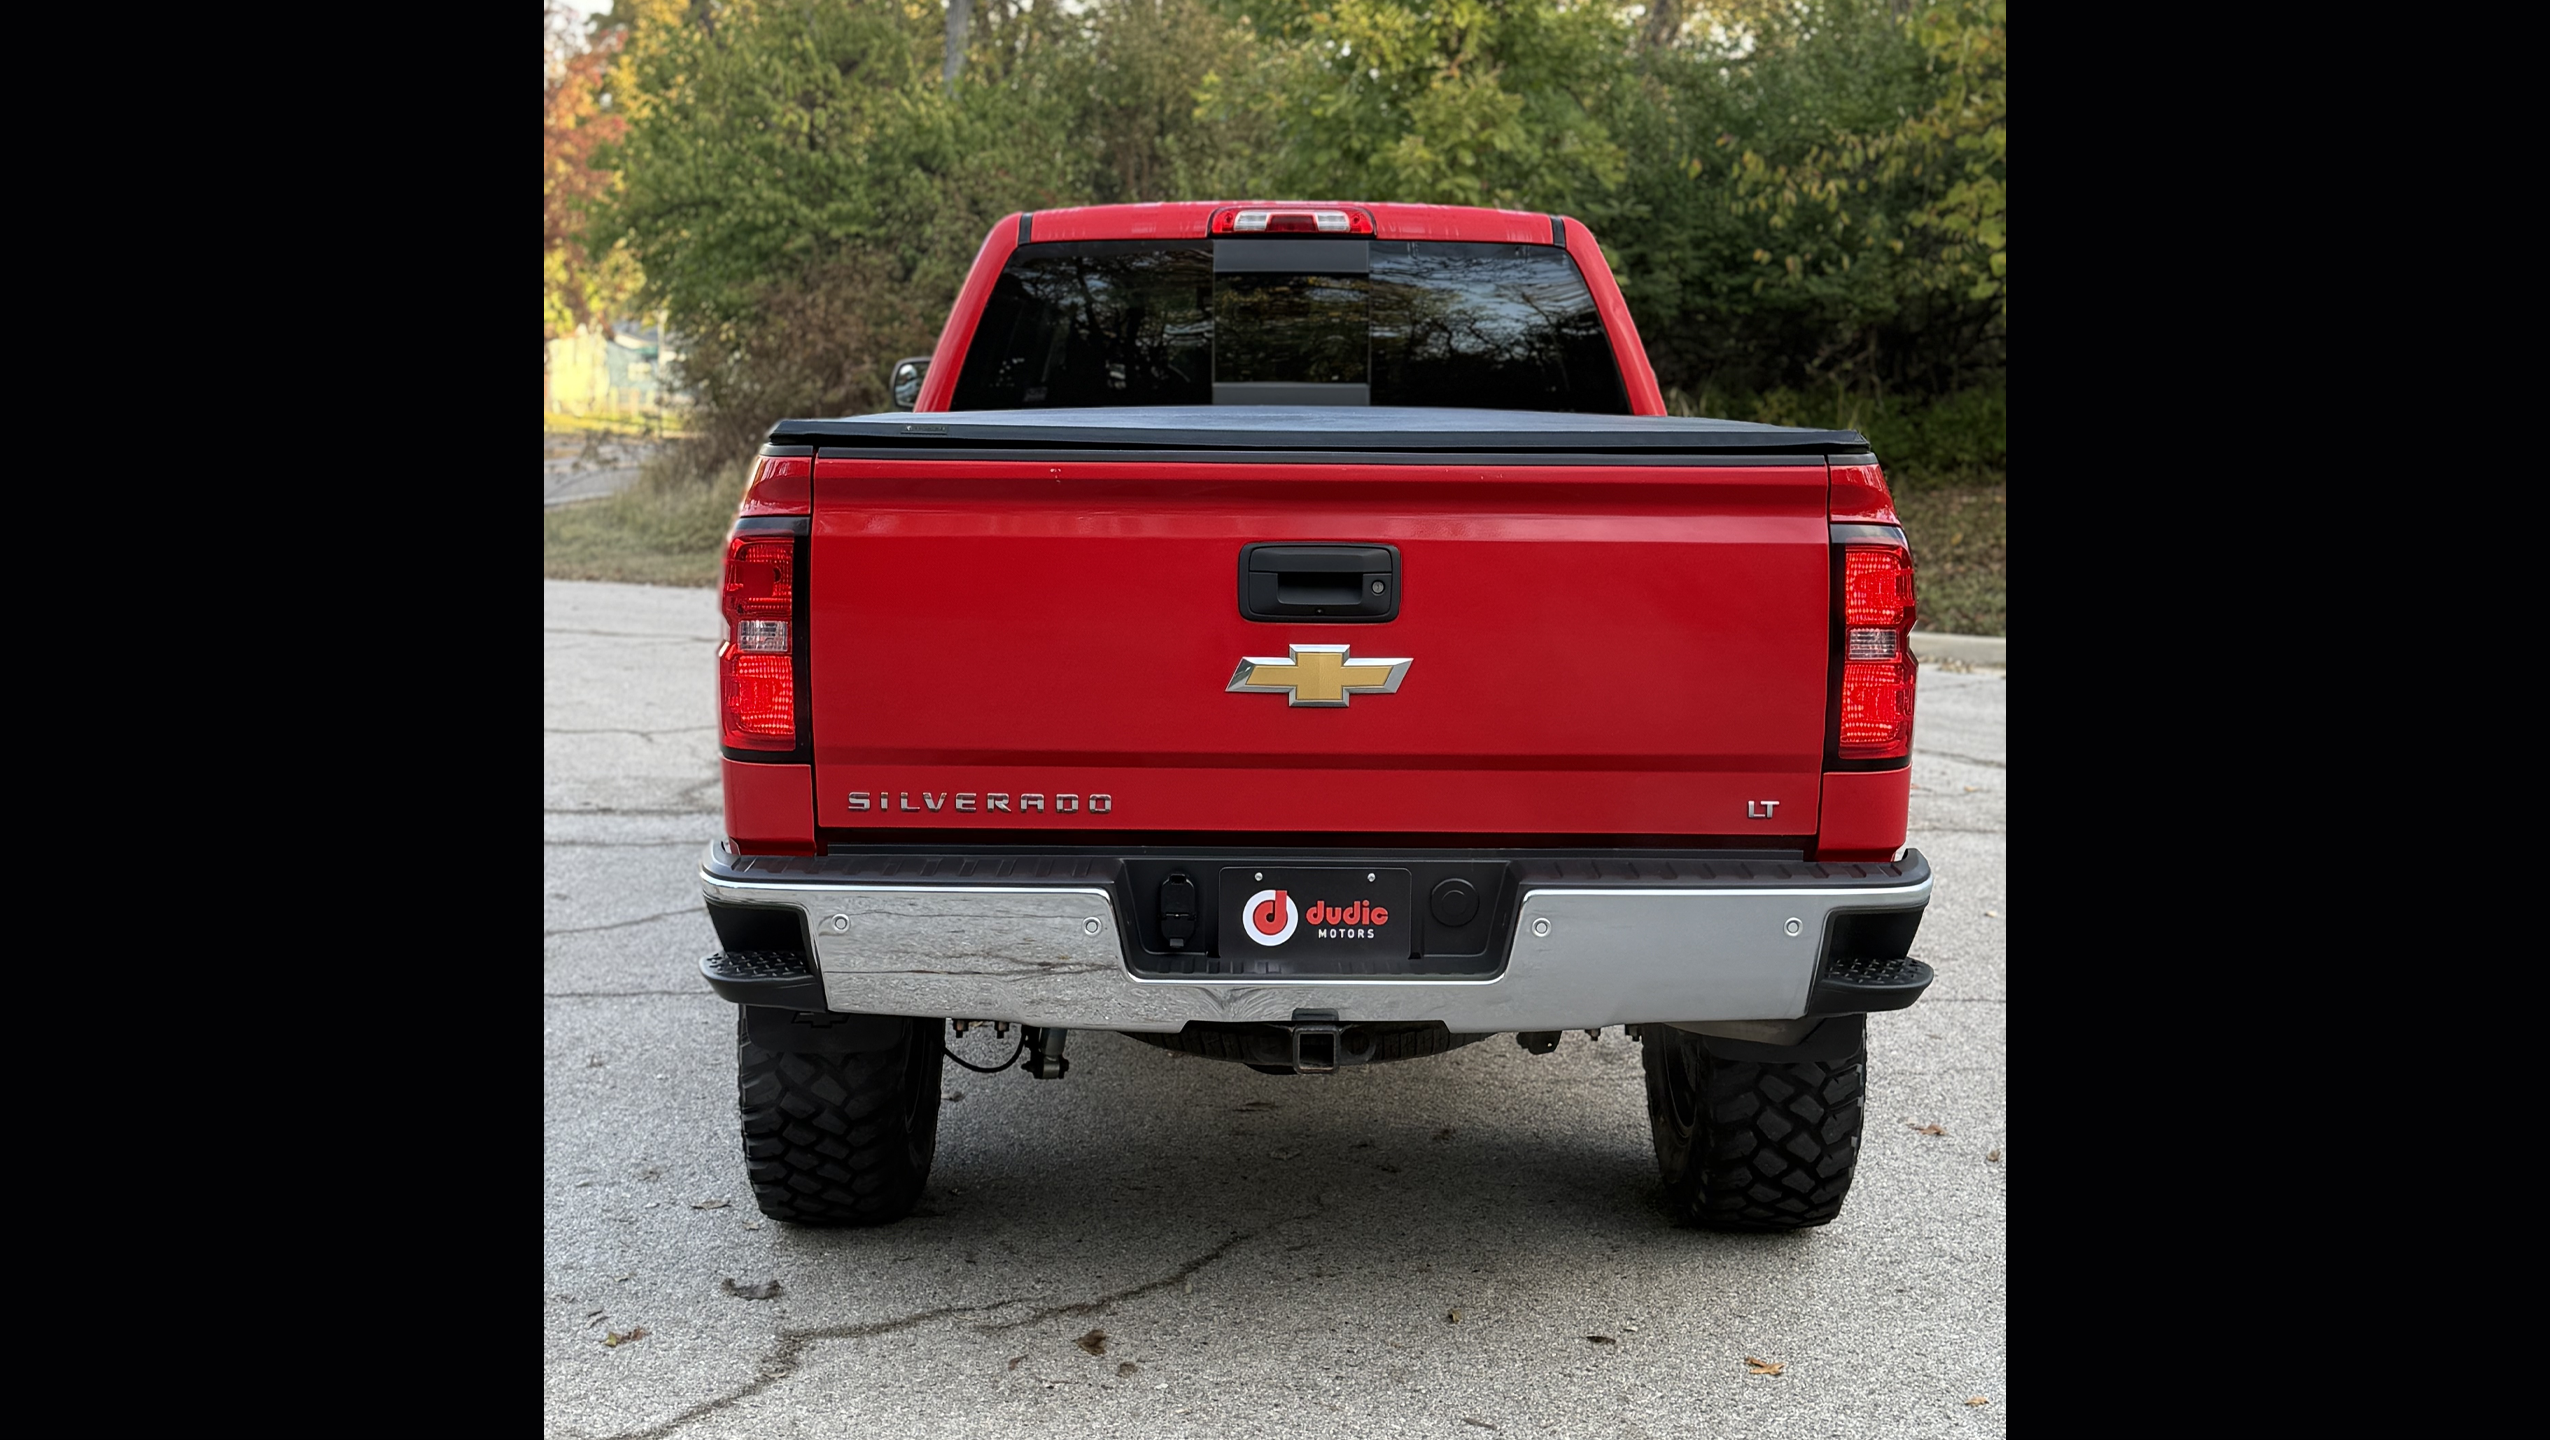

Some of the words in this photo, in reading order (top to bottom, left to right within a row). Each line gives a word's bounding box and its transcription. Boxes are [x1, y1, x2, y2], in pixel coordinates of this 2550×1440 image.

[848, 791, 1112, 813] SILVERADO
[1747, 800, 1780, 818] LT
[1305, 900, 1389, 926] dudic
[1318, 928, 1375, 939] MOTORS
